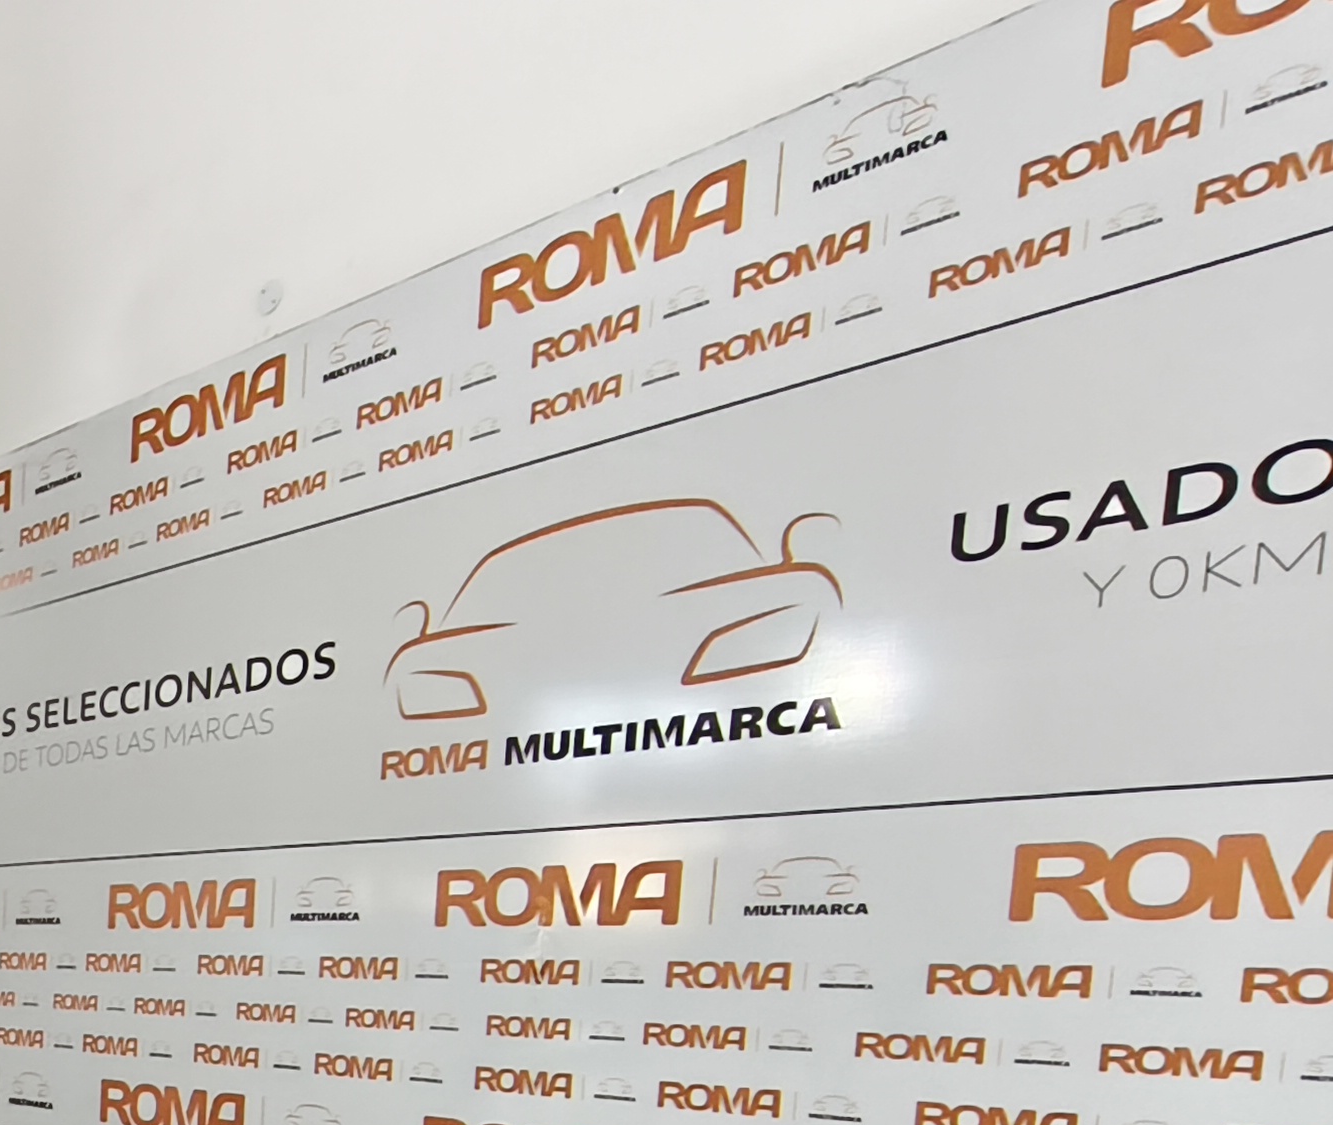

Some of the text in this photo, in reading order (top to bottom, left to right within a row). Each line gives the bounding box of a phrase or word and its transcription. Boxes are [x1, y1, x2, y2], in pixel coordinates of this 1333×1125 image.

[1019, 101, 1202, 198] ROMA
[477, 129, 948, 329] ROMA MULTIMARCA
[733, 223, 870, 298] ROMA
[929, 227, 1069, 299] ROMA
[532, 305, 640, 367] ROMA
[700, 312, 811, 371] ROMA
[130, 346, 397, 463] ROMA MULTIMARCA
[357, 378, 442, 429] ROMA
[531, 374, 622, 423] ROMA
[228, 430, 297, 472] ROMA
[379, 430, 452, 470] ROMA
[109, 477, 167, 512] ROMA
[263, 470, 326, 506] ROMA
[20, 514, 69, 543] ROMA
[157, 510, 210, 540] ROMA
[73, 539, 118, 565] ROMA
[1083, 564, 1127, 609] Y
[25, 640, 336, 733] SELECCIONADOS
[3, 748, 29, 774] DE
[35, 735, 109, 768] TODAS
[115, 727, 156, 756] LAS
[163, 708, 276, 749] MARCAS
[380, 697, 843, 781] ROMA MULTIMARCA
[107, 879, 359, 930] ROMA MULTIMARCA
[435, 859, 868, 928] ROMA MULTIMARCA
[0, 952, 46, 970] ROMA
[85, 954, 140, 973] ROMA
[198, 955, 263, 976] ROMA
[319, 956, 398, 981] ROMA
[481, 959, 580, 985] ROMA
[666, 961, 793, 991] ROMA
[927, 964, 1093, 1000] ROMA
[54, 995, 97, 1011] ROMA
[134, 998, 185, 1017] ROMA
[236, 1003, 295, 1023] ROMA
[346, 1008, 415, 1031] ROMA
[487, 1014, 571, 1040] ROMA
[643, 1022, 747, 1051] ROMA
[82, 1035, 138, 1056] ROMA
[193, 1044, 259, 1068] ROMA
[856, 1032, 986, 1065] ROMA
[315, 1053, 393, 1081] ROMA
[1099, 1044, 1264, 1083] ROMA
[475, 1066, 573, 1099] ROMA
[658, 1081, 782, 1119] ROMA
